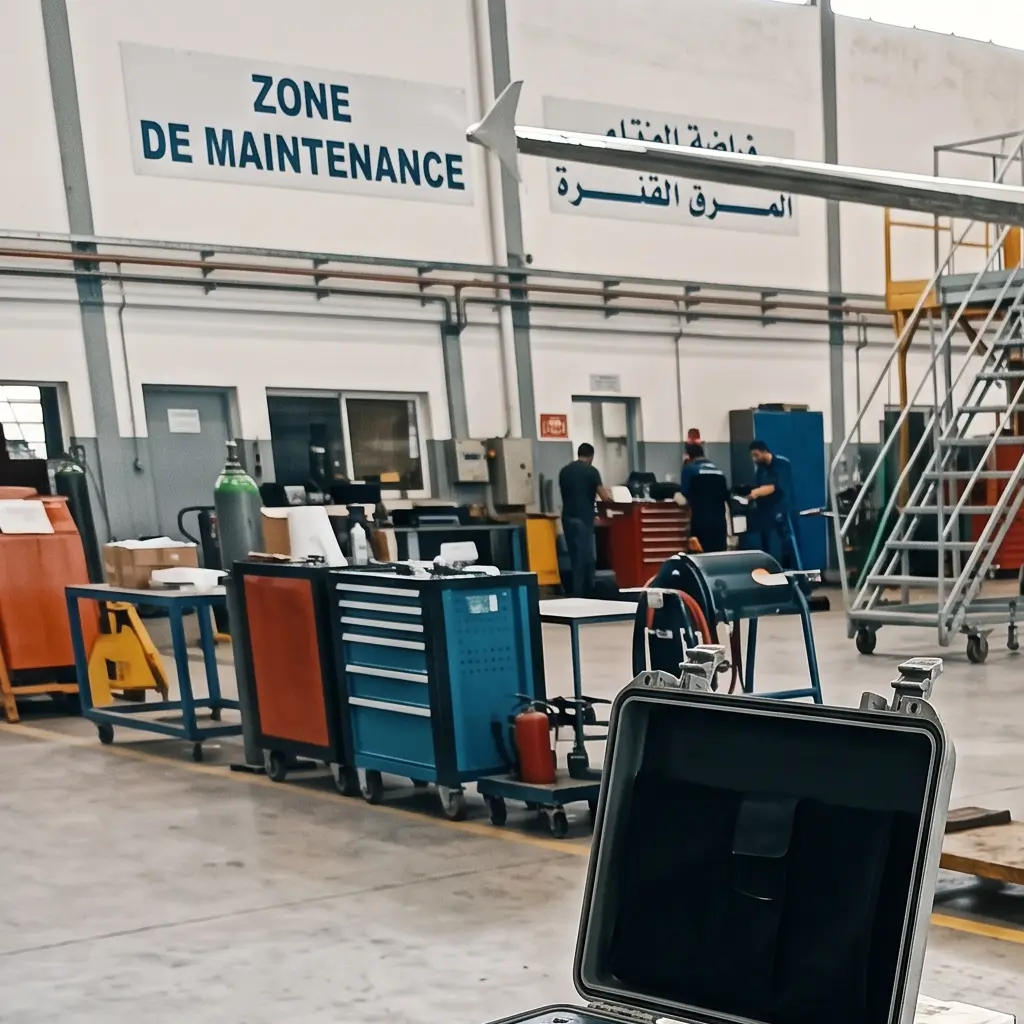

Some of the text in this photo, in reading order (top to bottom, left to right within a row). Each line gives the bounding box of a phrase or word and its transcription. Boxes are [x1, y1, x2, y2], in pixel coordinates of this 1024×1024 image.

[251, 73, 352, 123] ZONE
[140, 119, 466, 191] DE MAINTENANCE
